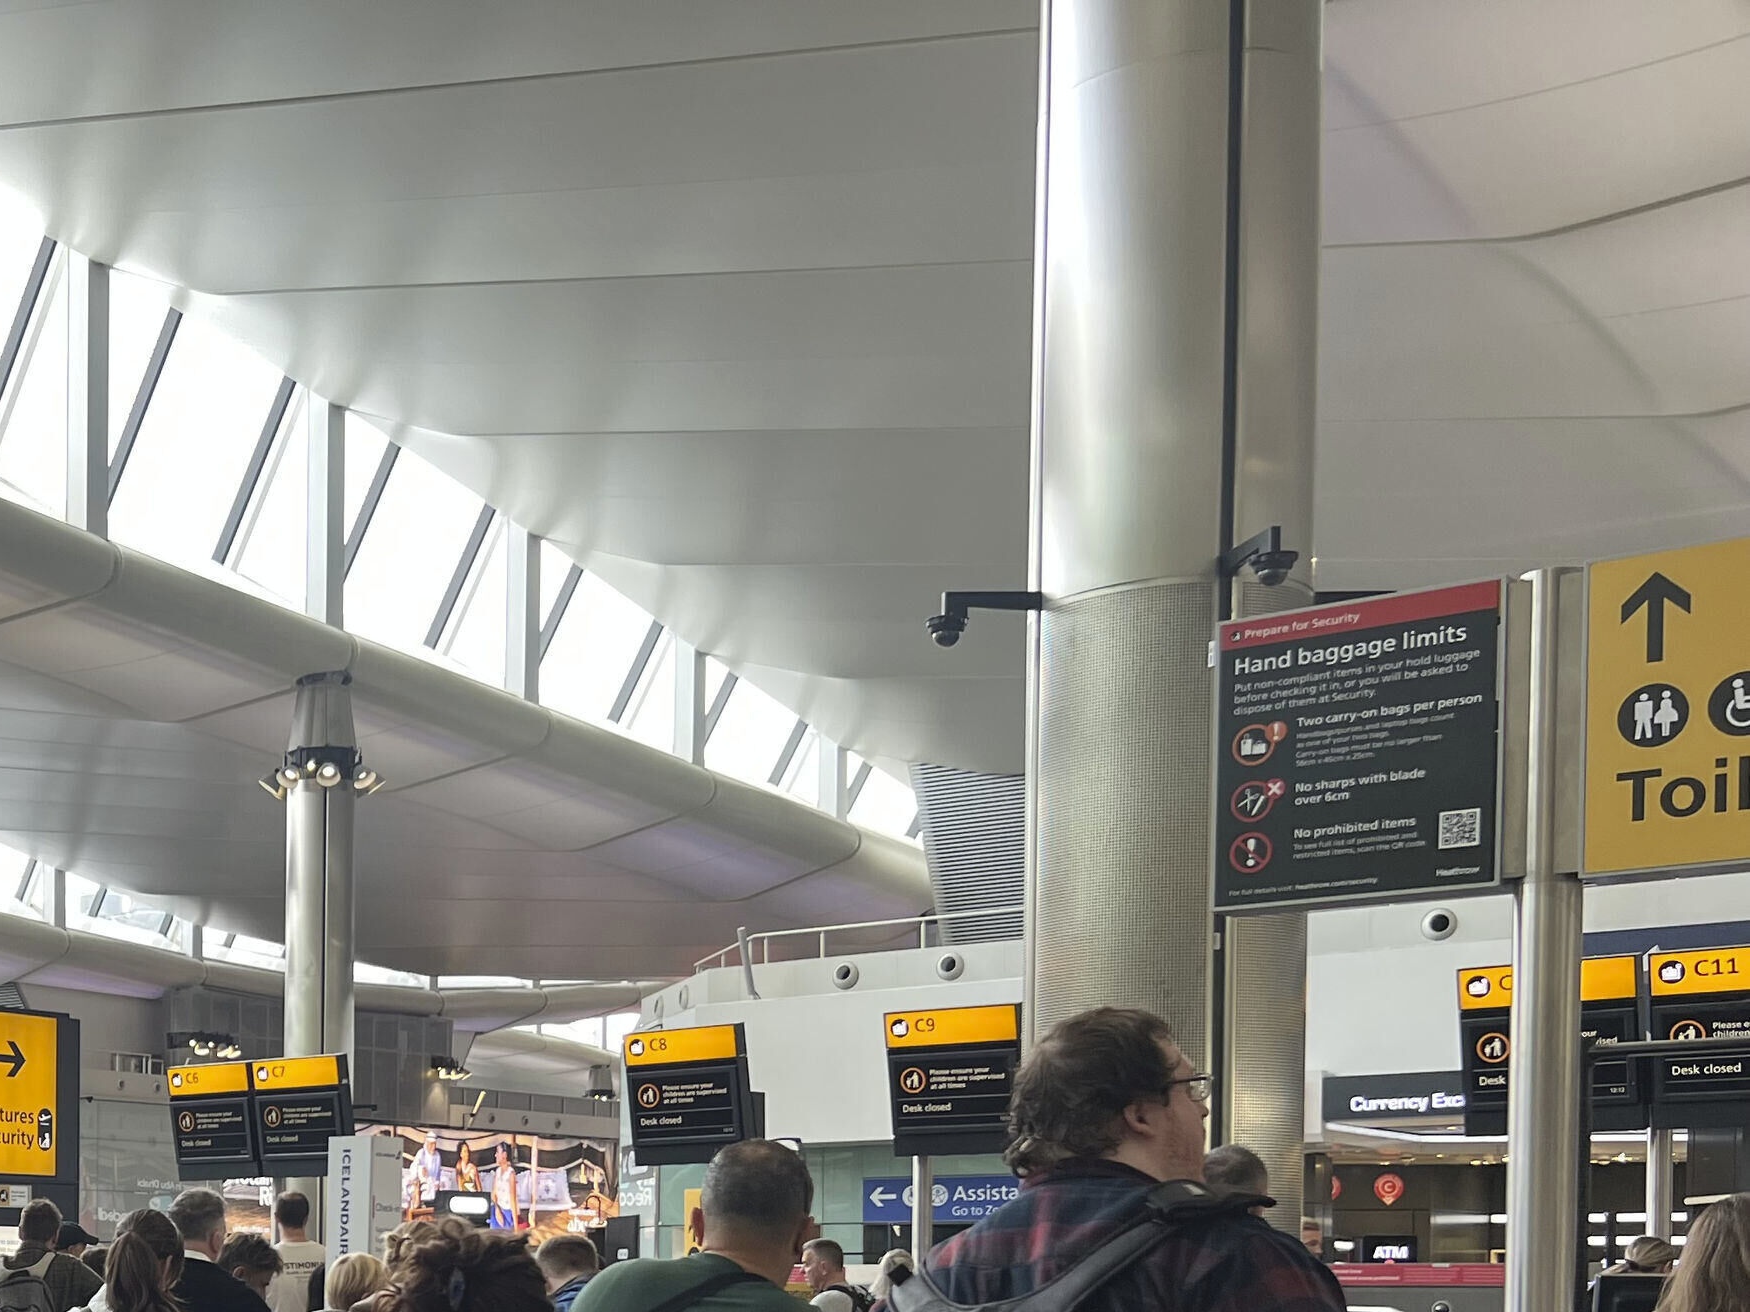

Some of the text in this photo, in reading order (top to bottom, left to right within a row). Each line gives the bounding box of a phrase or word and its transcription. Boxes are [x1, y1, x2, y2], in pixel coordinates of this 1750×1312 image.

[1245, 613, 1360, 639] Prepare for Security
[1234, 626, 1467, 675] Hand baggage limits
[1234, 649, 1480, 693] Put non-compliant items in your hold luggage
[1297, 694, 1482, 727] Two carry-on bags per person
[1295, 768, 1426, 792] No sharps with blade
[1616, 752, 1750, 821] Toil
[1295, 791, 1349, 805] over 6cm
[1293, 817, 1417, 839] No prohibited items
[1694, 958, 1740, 977] C11
[914, 1017, 935, 1033] C9
[1712, 1020, 1742, 1030] Please
[649, 1037, 668, 1052] C8
[271, 1066, 286, 1078] C7
[1671, 1062, 1742, 1075] Desk closed
[185, 1072, 199, 1085] C6
[1479, 1075, 1506, 1086] Desk
[902, 1102, 951, 1113] Desk closed
[1349, 1094, 1429, 1112] Currency
[640, 1116, 682, 1126] Desk closed
[266, 1135, 280, 1143] Desk
[340, 1149, 351, 1258] ICELANDAIR
[952, 1205, 968, 1216] Go
[971, 1206, 983, 1216] to
[1373, 1245, 1409, 1259] ATM
